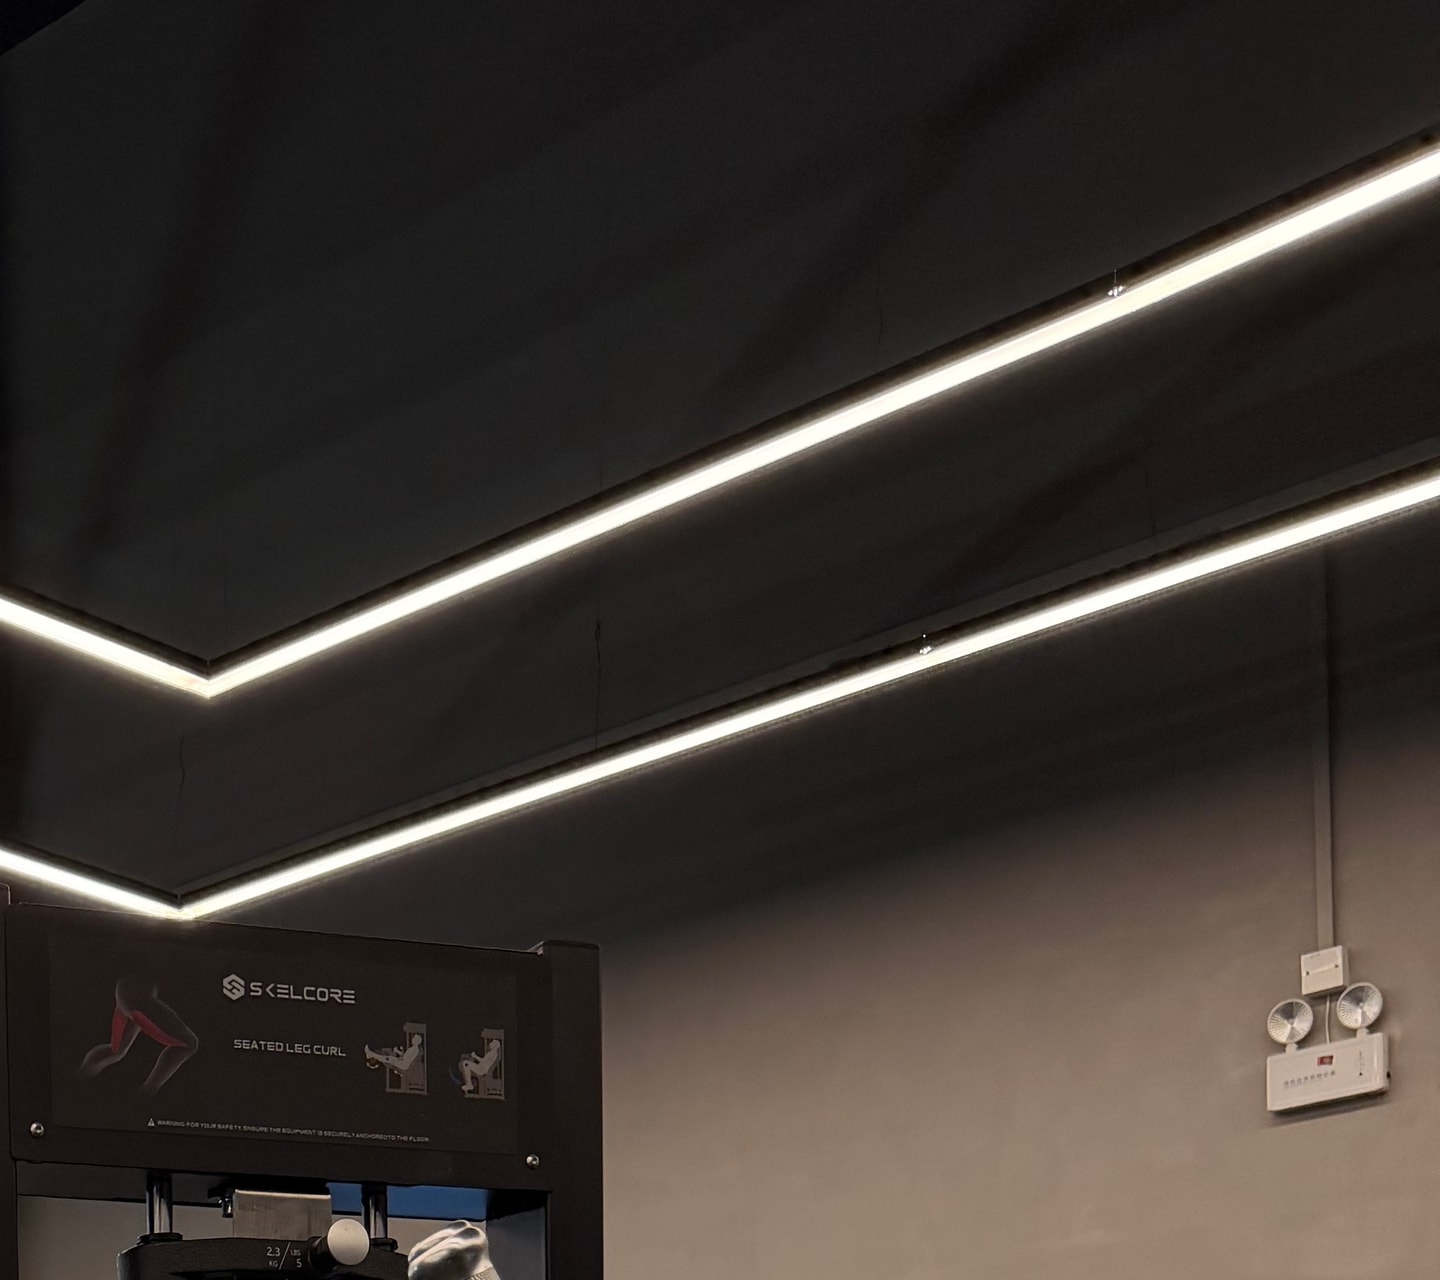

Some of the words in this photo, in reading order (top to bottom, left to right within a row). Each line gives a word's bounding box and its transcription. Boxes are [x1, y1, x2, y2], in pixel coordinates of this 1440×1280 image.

[249, 977, 357, 1005] SKELCORE
[233, 1039, 285, 1052] SEATED
[285, 1043, 311, 1054] LEG
[313, 1045, 347, 1057] CURL
[266, 1246, 281, 1257] 2.3
[296, 1258, 302, 1268] 5
